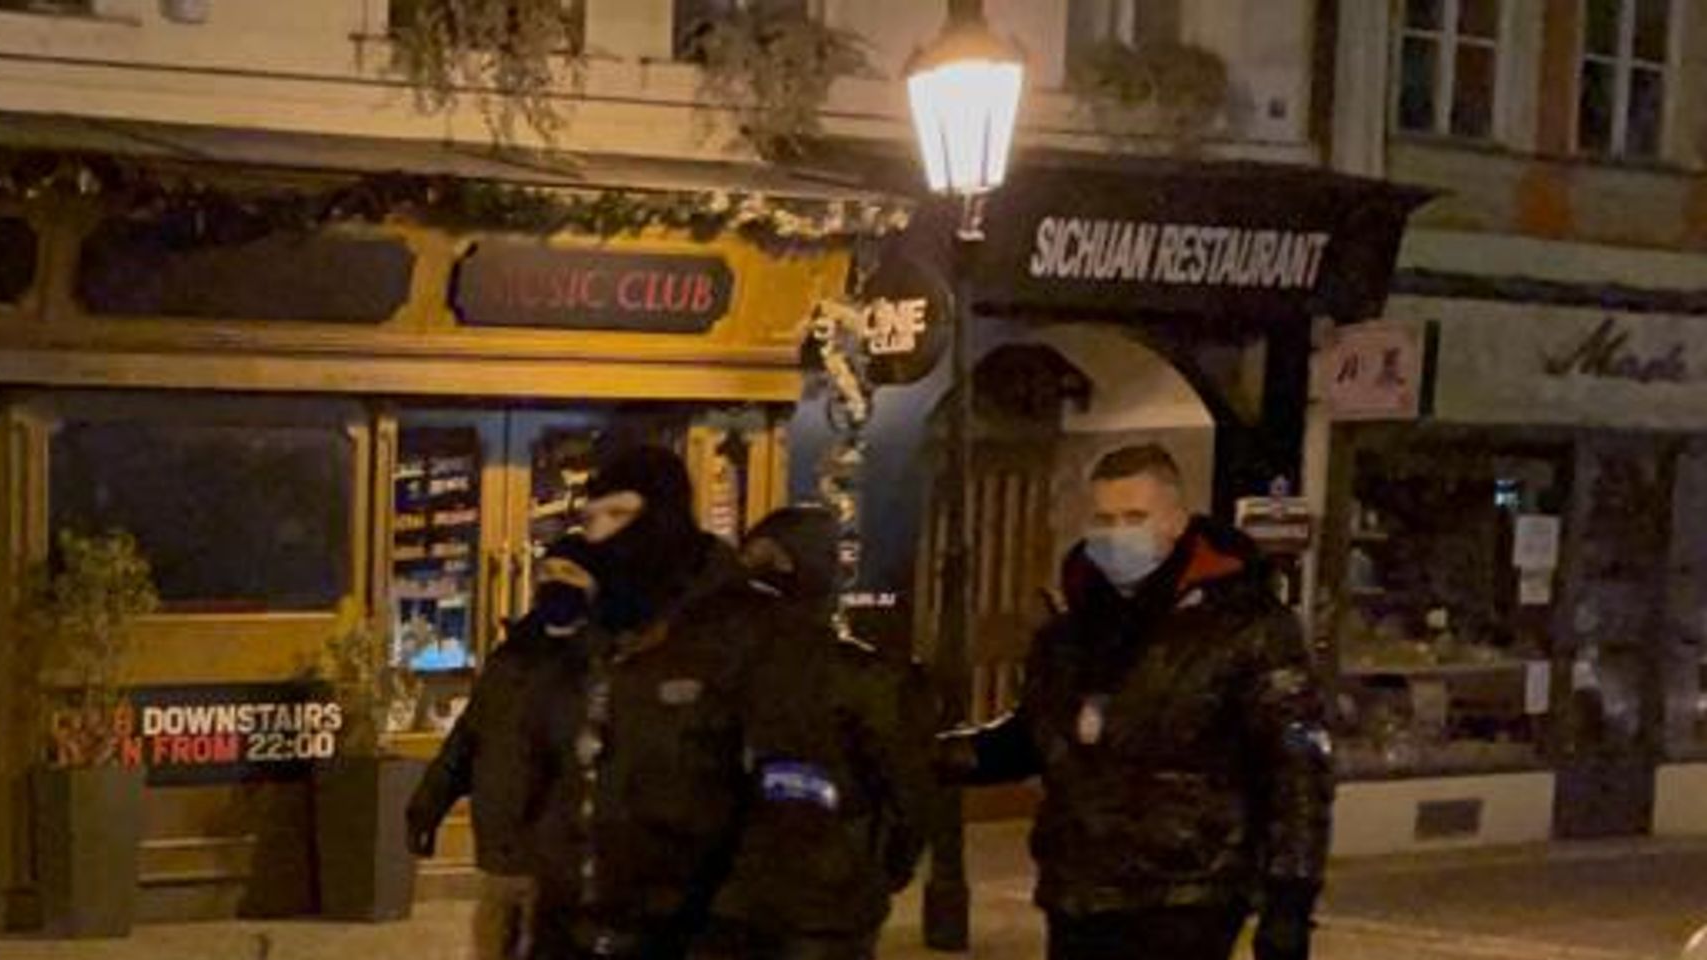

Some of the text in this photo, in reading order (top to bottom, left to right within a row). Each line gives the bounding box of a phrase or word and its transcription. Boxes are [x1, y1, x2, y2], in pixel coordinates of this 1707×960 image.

[1030, 217, 1330, 289] SICHUAN RESTAURANT
[615, 268, 715, 312] CLUB
[142, 702, 343, 736] DOWNSTAIRS
[154, 735, 240, 765] FROM
[247, 732, 335, 761] 22:00
